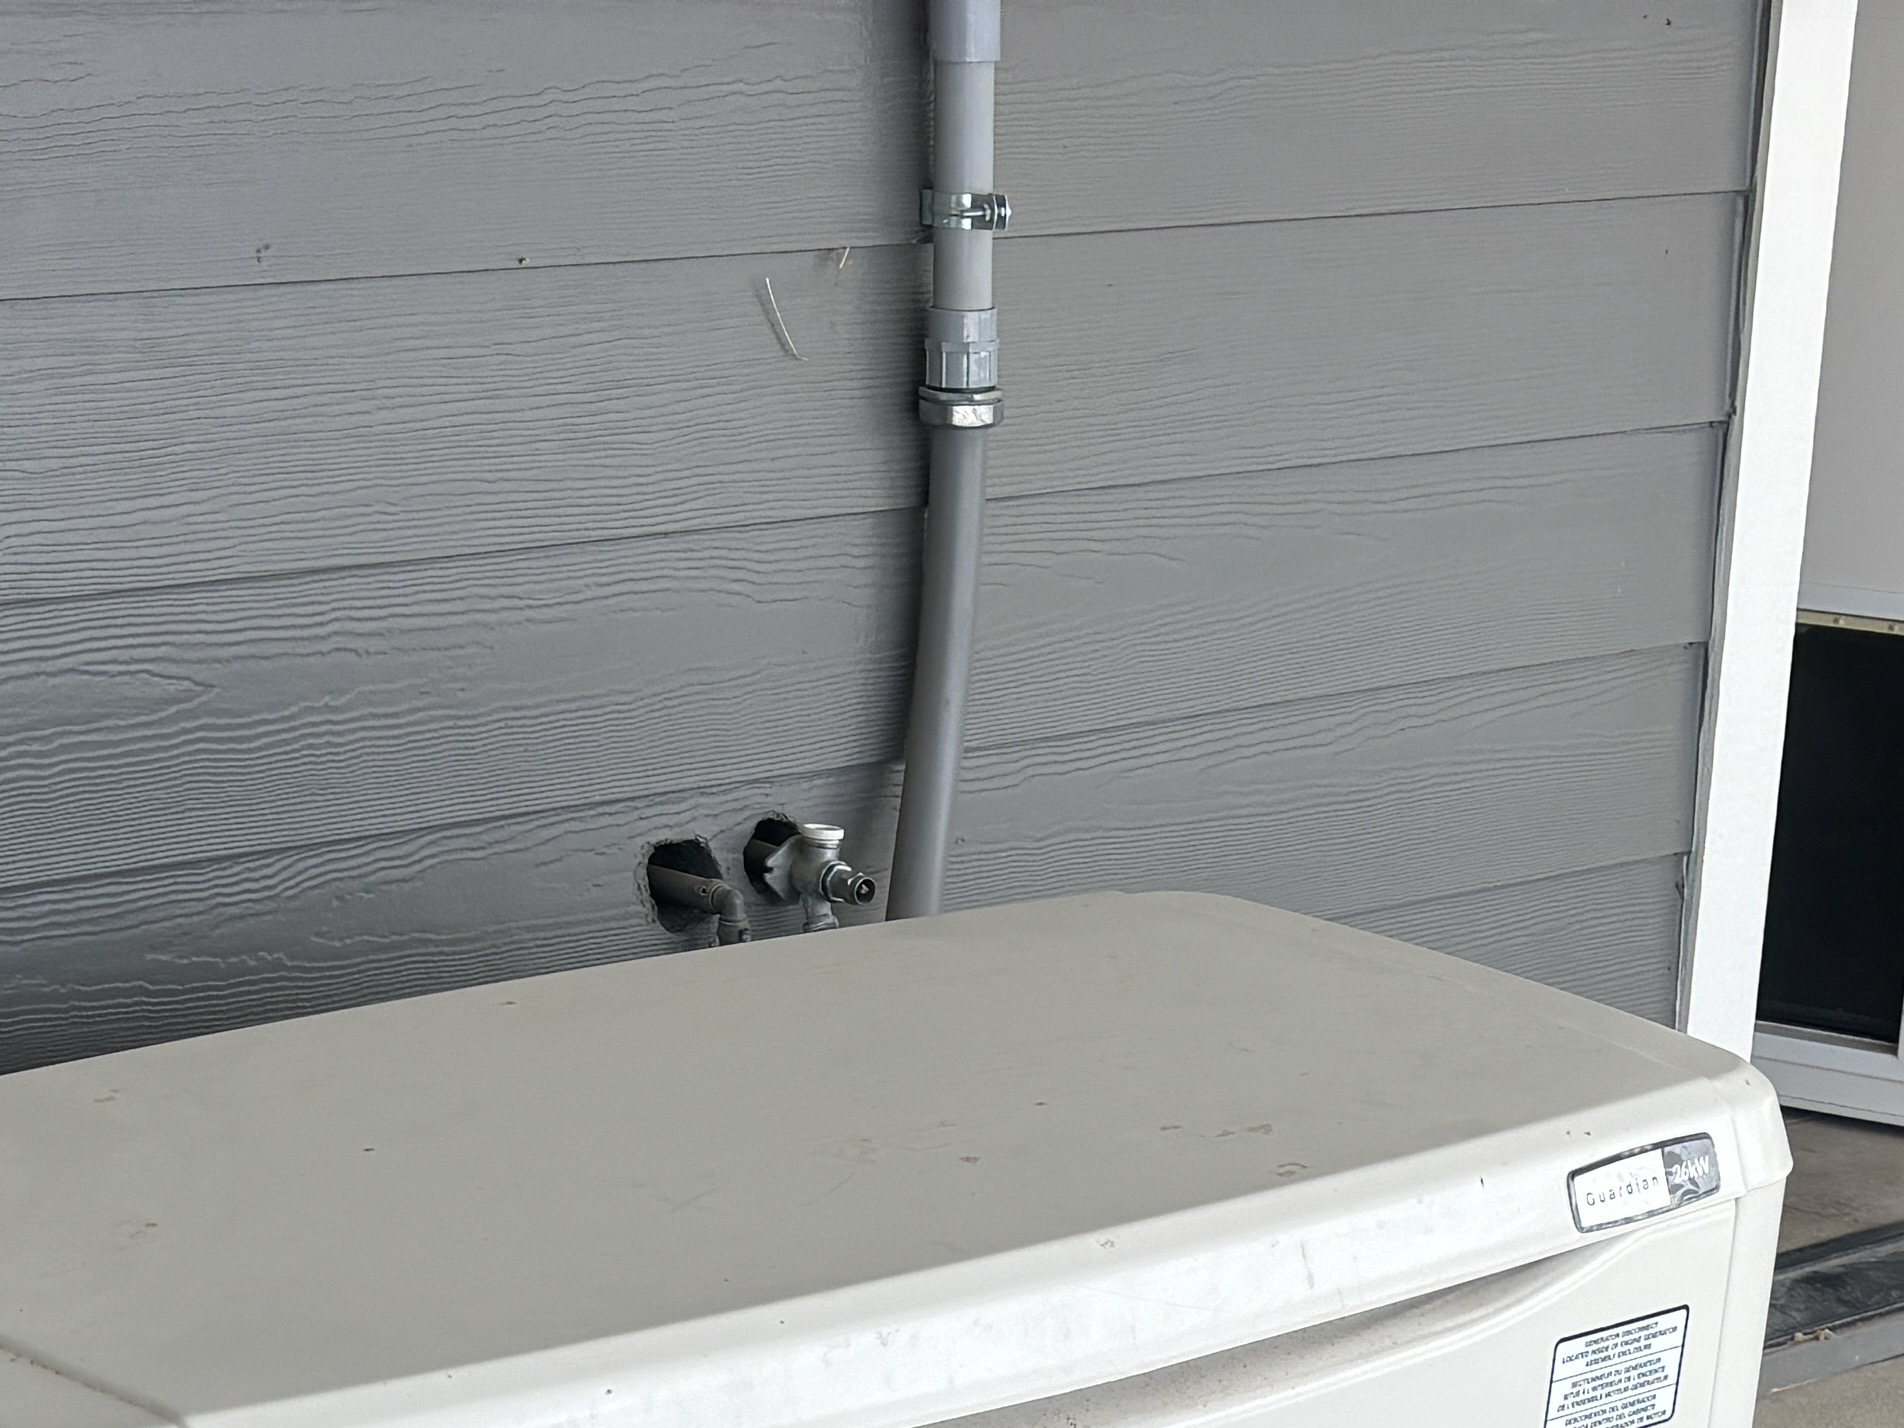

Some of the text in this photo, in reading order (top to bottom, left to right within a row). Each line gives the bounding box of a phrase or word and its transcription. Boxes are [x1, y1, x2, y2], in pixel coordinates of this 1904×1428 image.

[1672, 1155, 1710, 1184] 26kW
[1586, 1174, 1659, 1206] Guardian
[1561, 1350, 1589, 1364] LOCATED
[1590, 1344, 1609, 1356] INSIDE
[1620, 1335, 1641, 1347] ENGINE
[1643, 1325, 1677, 1341] GENERATOR
[1584, 1321, 1658, 1348] GENERATOR DISCONNECT
[1585, 1342, 1651, 1367] ASSEMBLY ENCLOSURE
